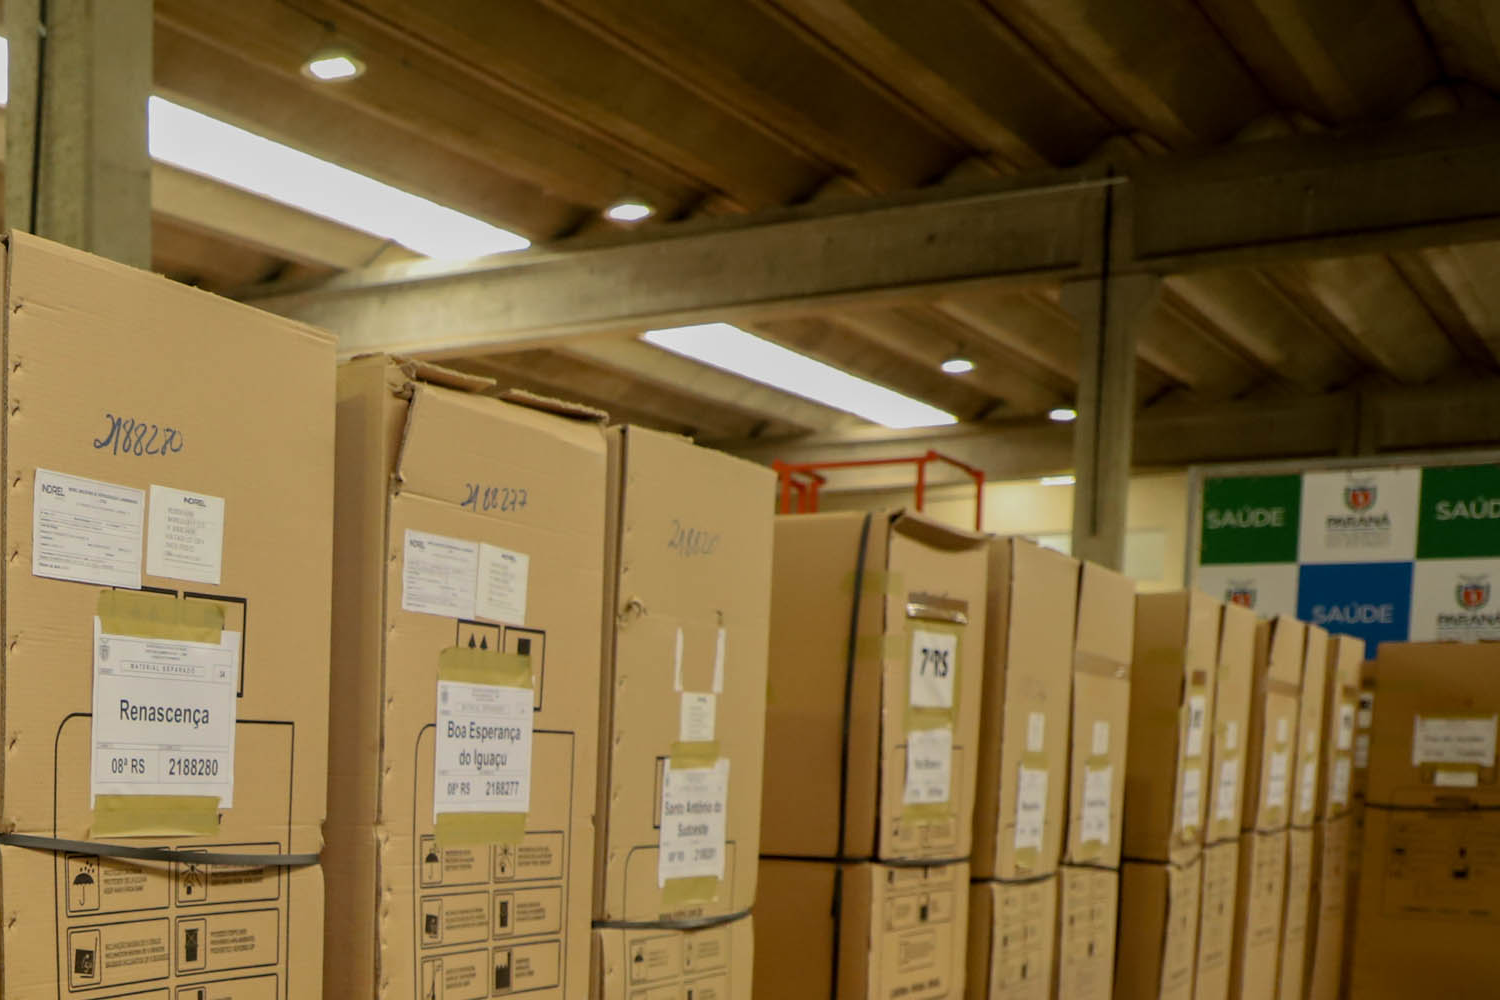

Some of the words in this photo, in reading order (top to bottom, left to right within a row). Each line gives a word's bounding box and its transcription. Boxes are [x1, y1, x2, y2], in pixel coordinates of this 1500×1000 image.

[1205, 505, 1285, 530] SAÚDE
[1311, 602, 1395, 625] SAÚDE
[120, 699, 210, 728] Renascença
[447, 720, 466, 739] Boa
[469, 721, 522, 743] Esperança
[131, 759, 145, 774] RS
[169, 758, 218, 776] 2188280
[459, 749, 471, 766] do
[474, 749, 508, 770] Iguaçu
